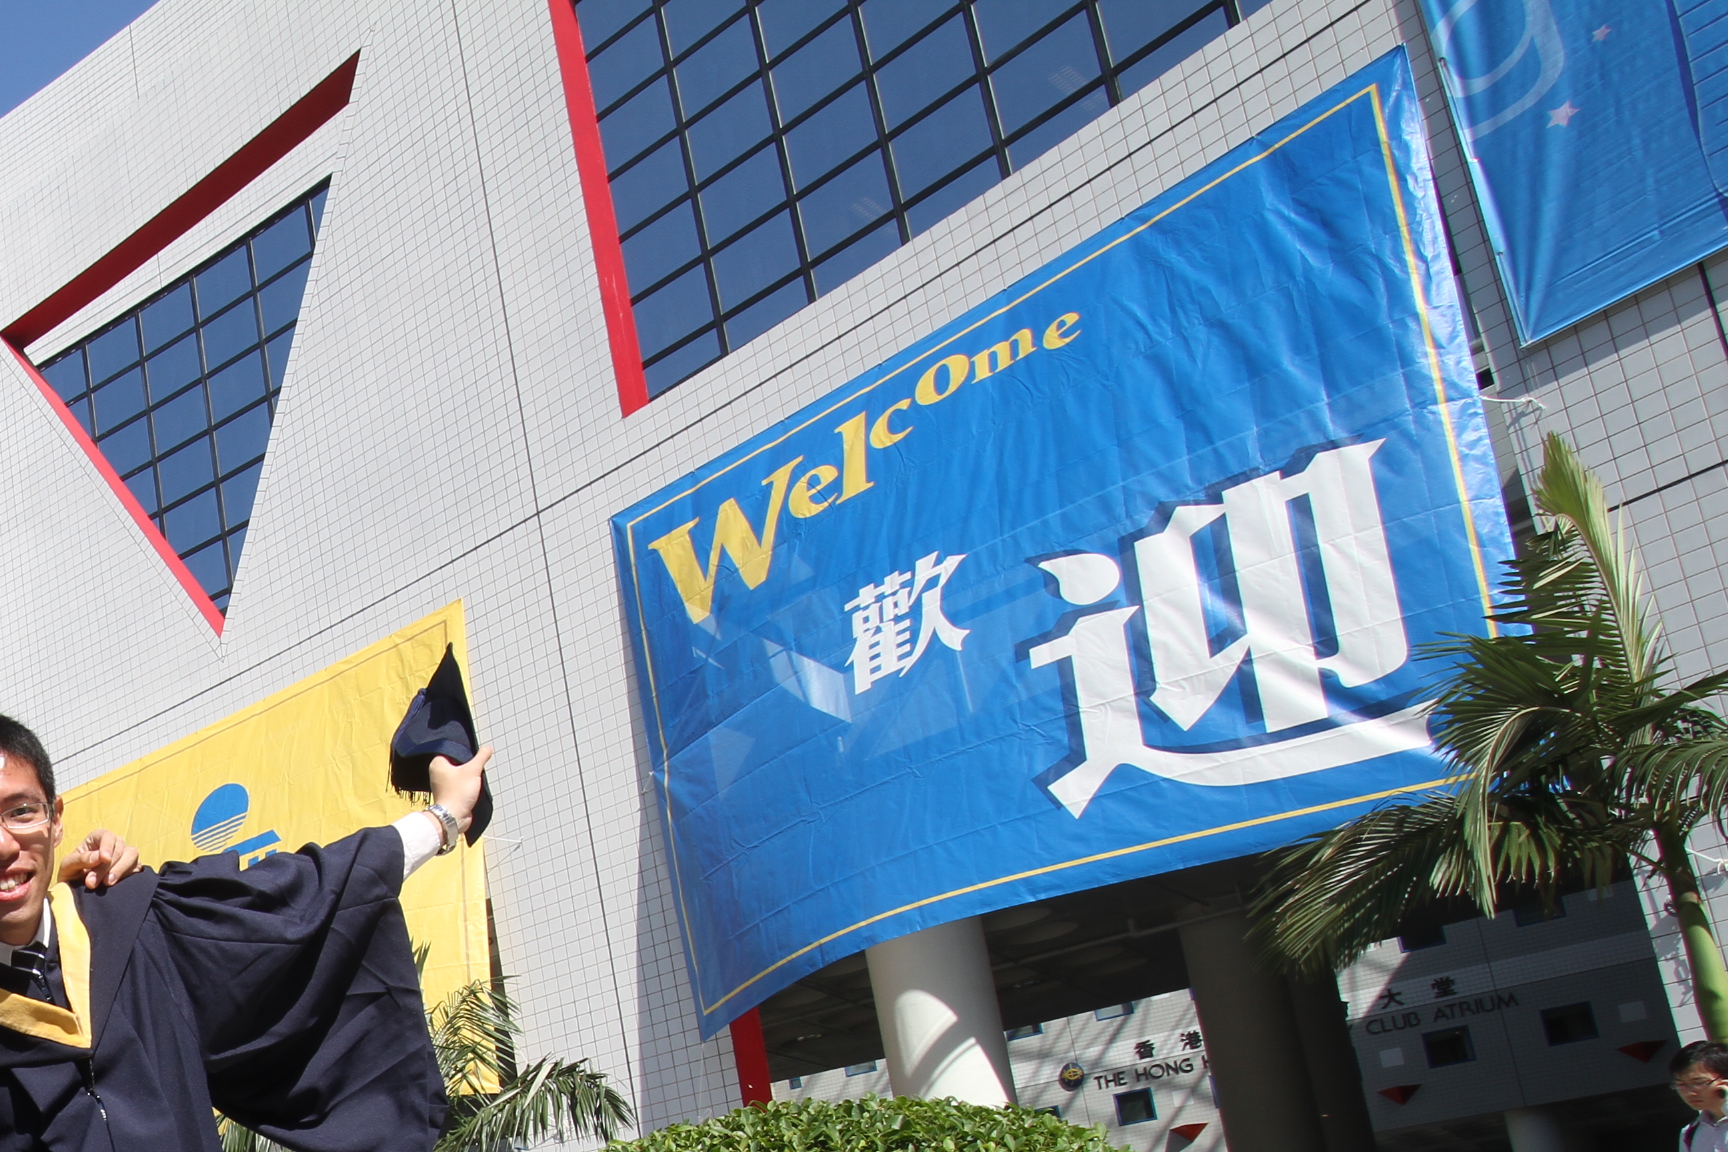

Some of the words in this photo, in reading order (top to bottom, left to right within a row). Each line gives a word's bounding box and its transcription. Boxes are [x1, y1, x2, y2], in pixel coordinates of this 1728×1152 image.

[647, 311, 1082, 625] Welcome
[844, 437, 1439, 820] 歡迎
[1093, 1070, 1129, 1090] THE
[1134, 1057, 1195, 1082] HONG
[1365, 1011, 1422, 1035] CLUB
[1432, 992, 1520, 1023] ATRIUM
